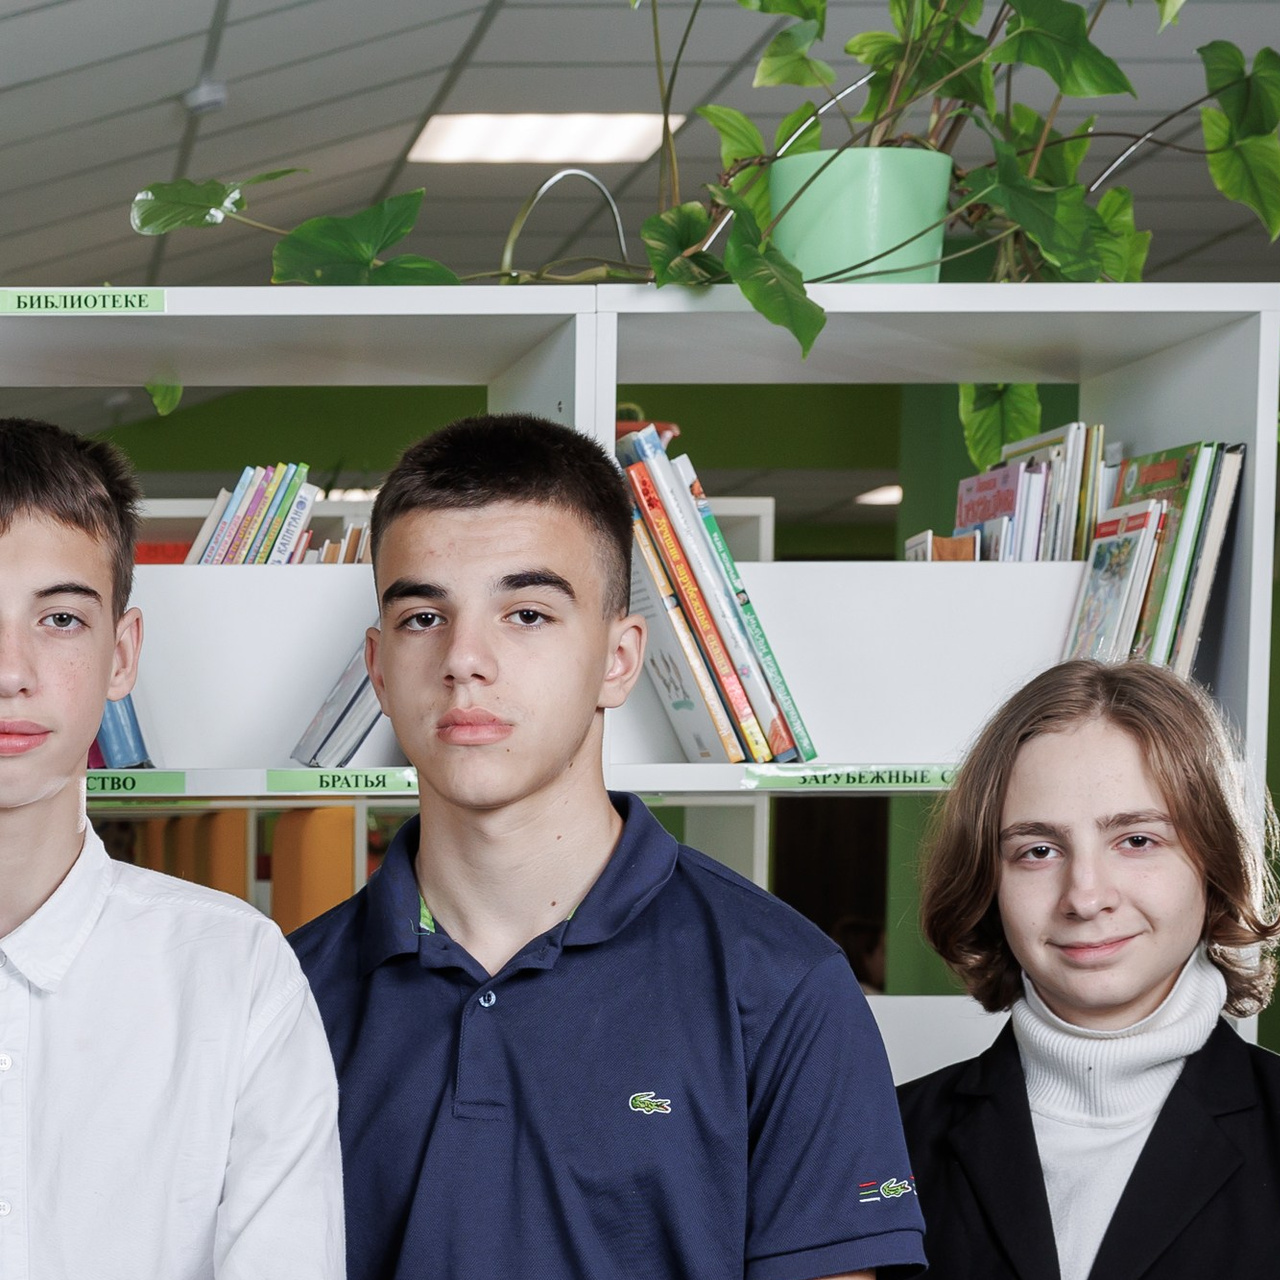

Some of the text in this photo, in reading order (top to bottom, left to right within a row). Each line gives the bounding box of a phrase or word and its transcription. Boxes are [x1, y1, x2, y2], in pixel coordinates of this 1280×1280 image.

[16, 294, 150, 309] БИБЛИОТЕКЕ
[676, 563, 711, 632] зарубежные
[706, 633, 730, 675] сказки
[319, 774, 387, 788] БРАТЬЯ
